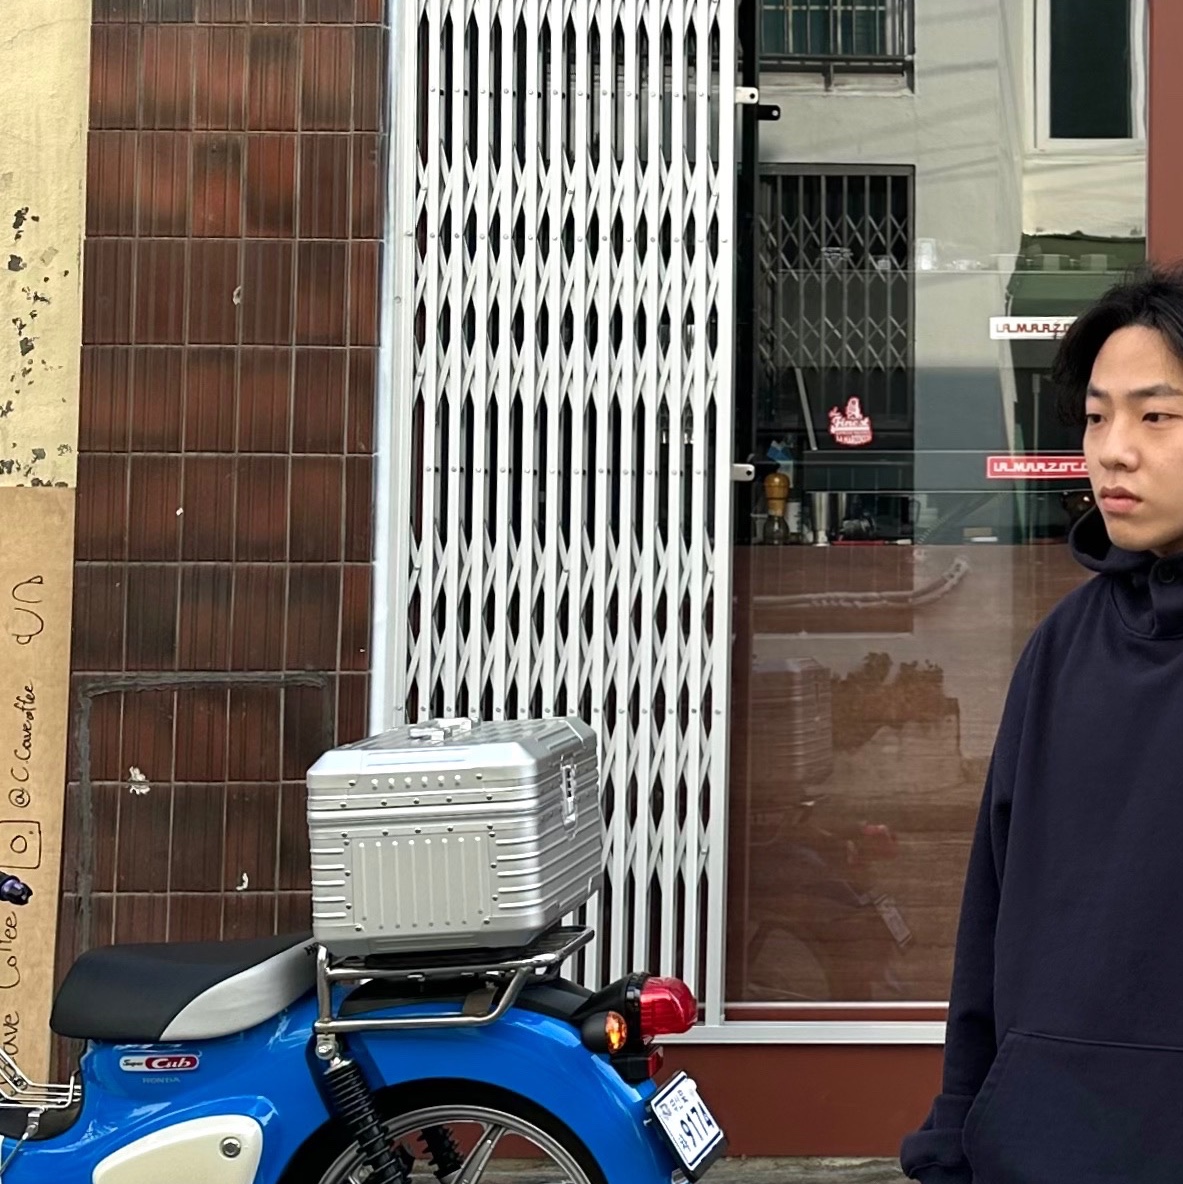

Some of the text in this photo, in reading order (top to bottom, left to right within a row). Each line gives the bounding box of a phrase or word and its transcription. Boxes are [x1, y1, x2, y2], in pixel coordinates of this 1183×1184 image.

[122, 1057, 191, 1068] Super Cub
[680, 1101, 715, 1148] 9174
